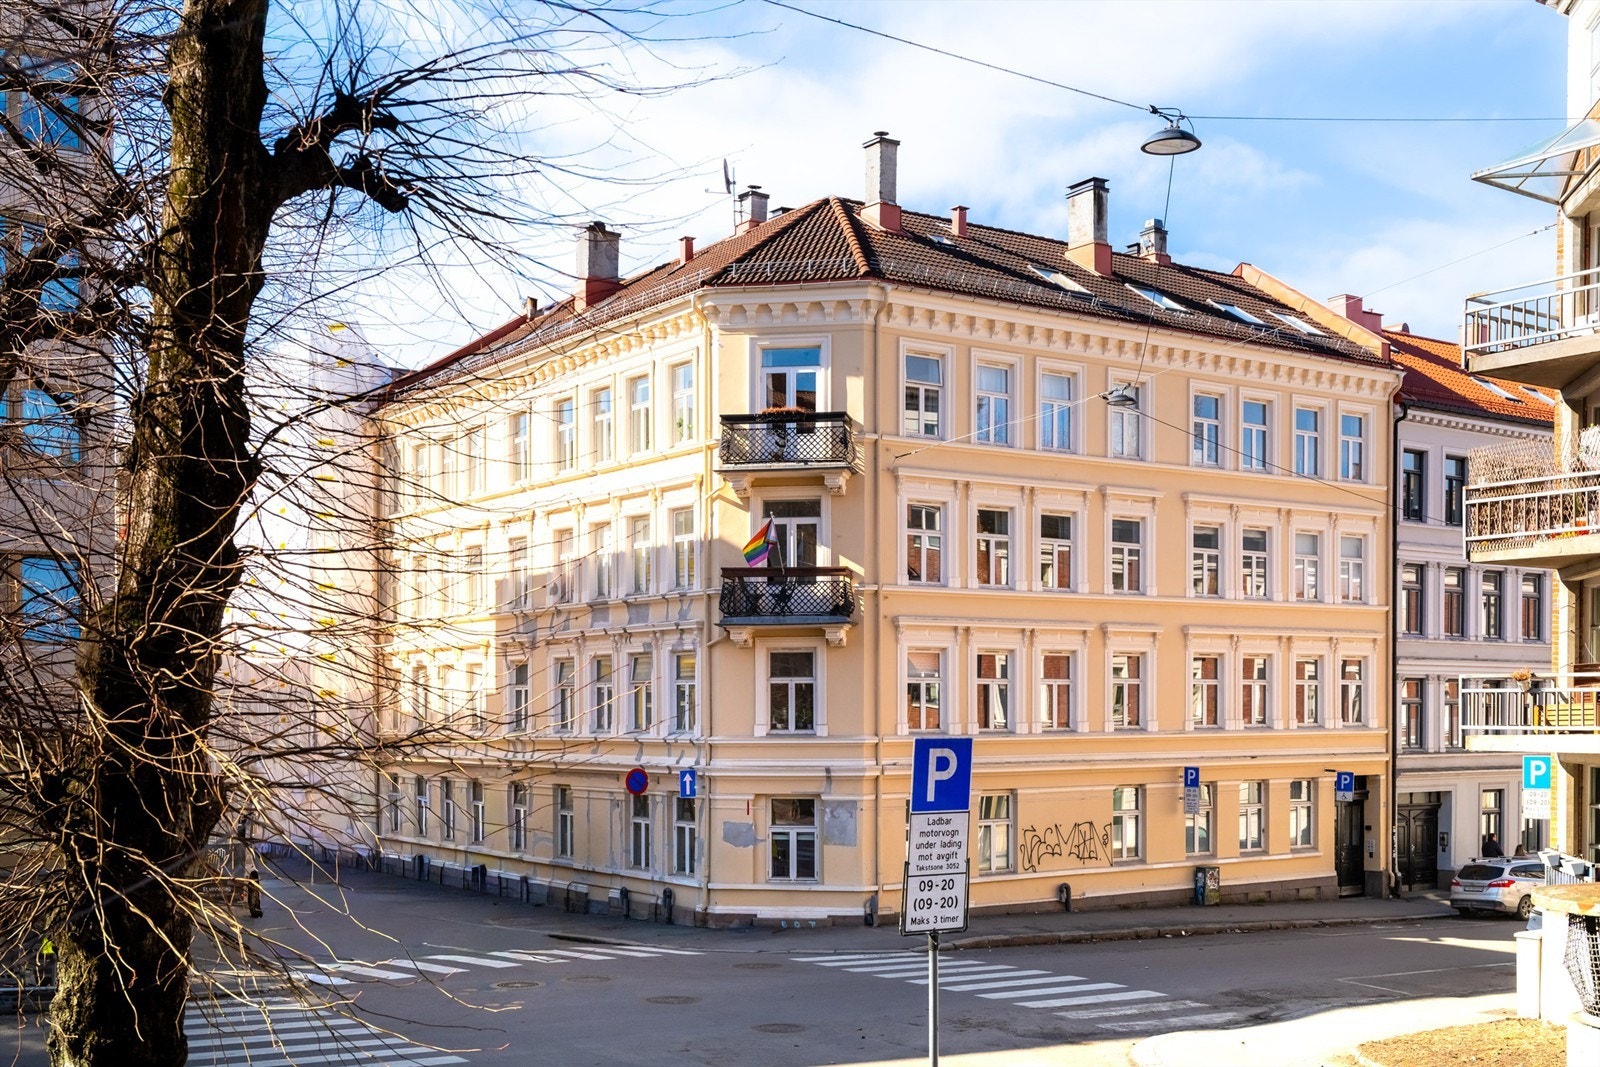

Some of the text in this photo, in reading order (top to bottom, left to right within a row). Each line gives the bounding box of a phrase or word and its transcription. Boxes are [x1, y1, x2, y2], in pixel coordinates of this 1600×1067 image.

[926, 748, 958, 802] P
[1187, 769, 1196, 785] P
[1530, 760, 1547, 785] P
[1341, 774, 1350, 789] P
[927, 816, 952, 826] Ladbar
[919, 829, 960, 839] motorvogn
[915, 839, 962, 850] under lading
[918, 850, 958, 862] mot avgift
[916, 864, 943, 872] Takstsone
[919, 878, 955, 892] 09-20
[913, 895, 959, 912] (09-20)
[910, 915, 960, 926] Maks 3 timer
